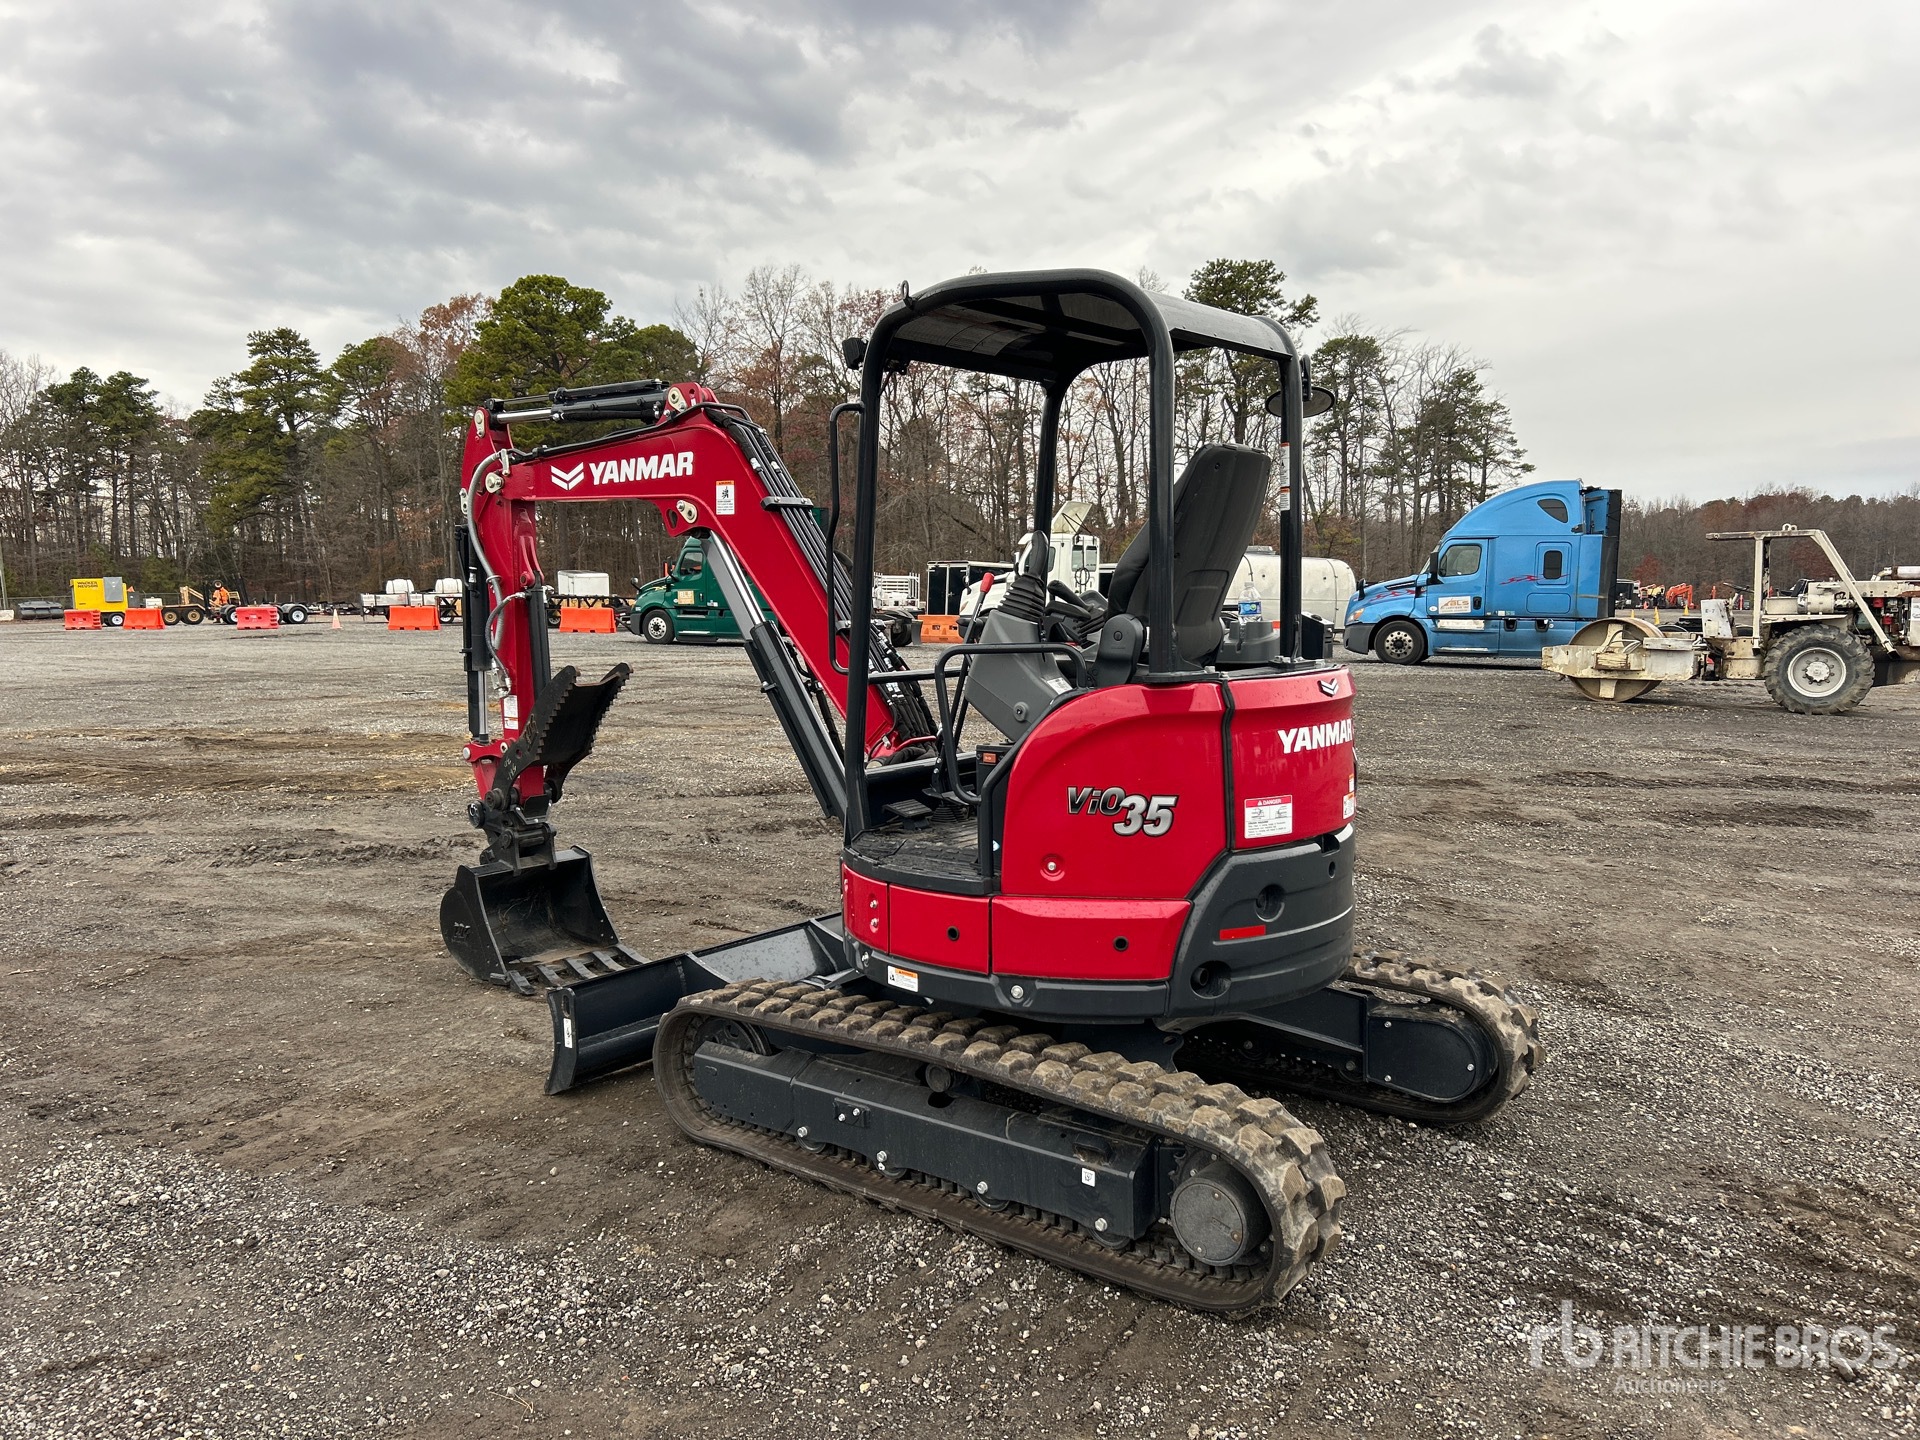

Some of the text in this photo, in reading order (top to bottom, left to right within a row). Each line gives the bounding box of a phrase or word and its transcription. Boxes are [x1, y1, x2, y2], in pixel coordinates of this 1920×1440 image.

[589, 451, 694, 485] YANMAR
[1277, 718, 1353, 754] YANMAR
[1262, 798, 1282, 806] DANGER
